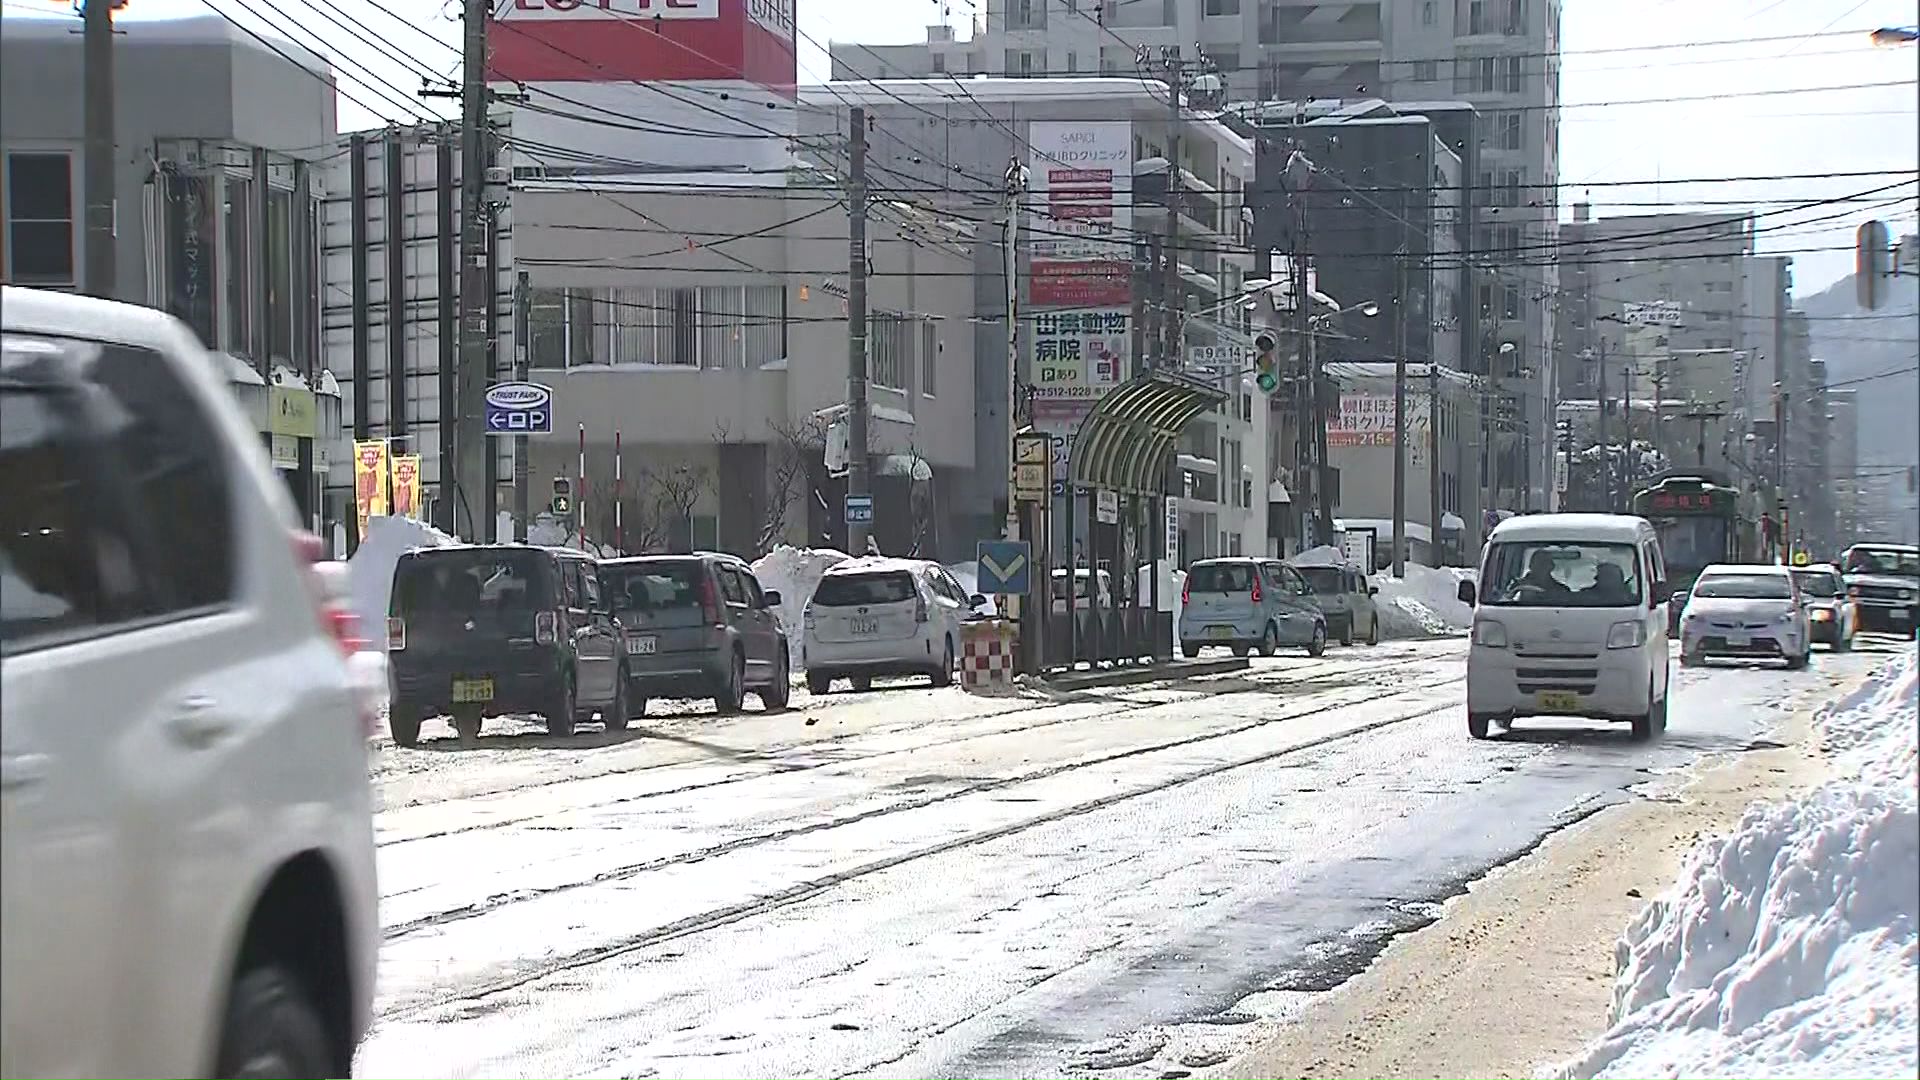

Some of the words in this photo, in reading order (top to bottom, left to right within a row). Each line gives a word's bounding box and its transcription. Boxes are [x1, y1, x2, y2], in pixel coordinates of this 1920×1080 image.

[1036, 313, 1126, 335] 山鼻動物
[1036, 339, 1080, 361] 病院
